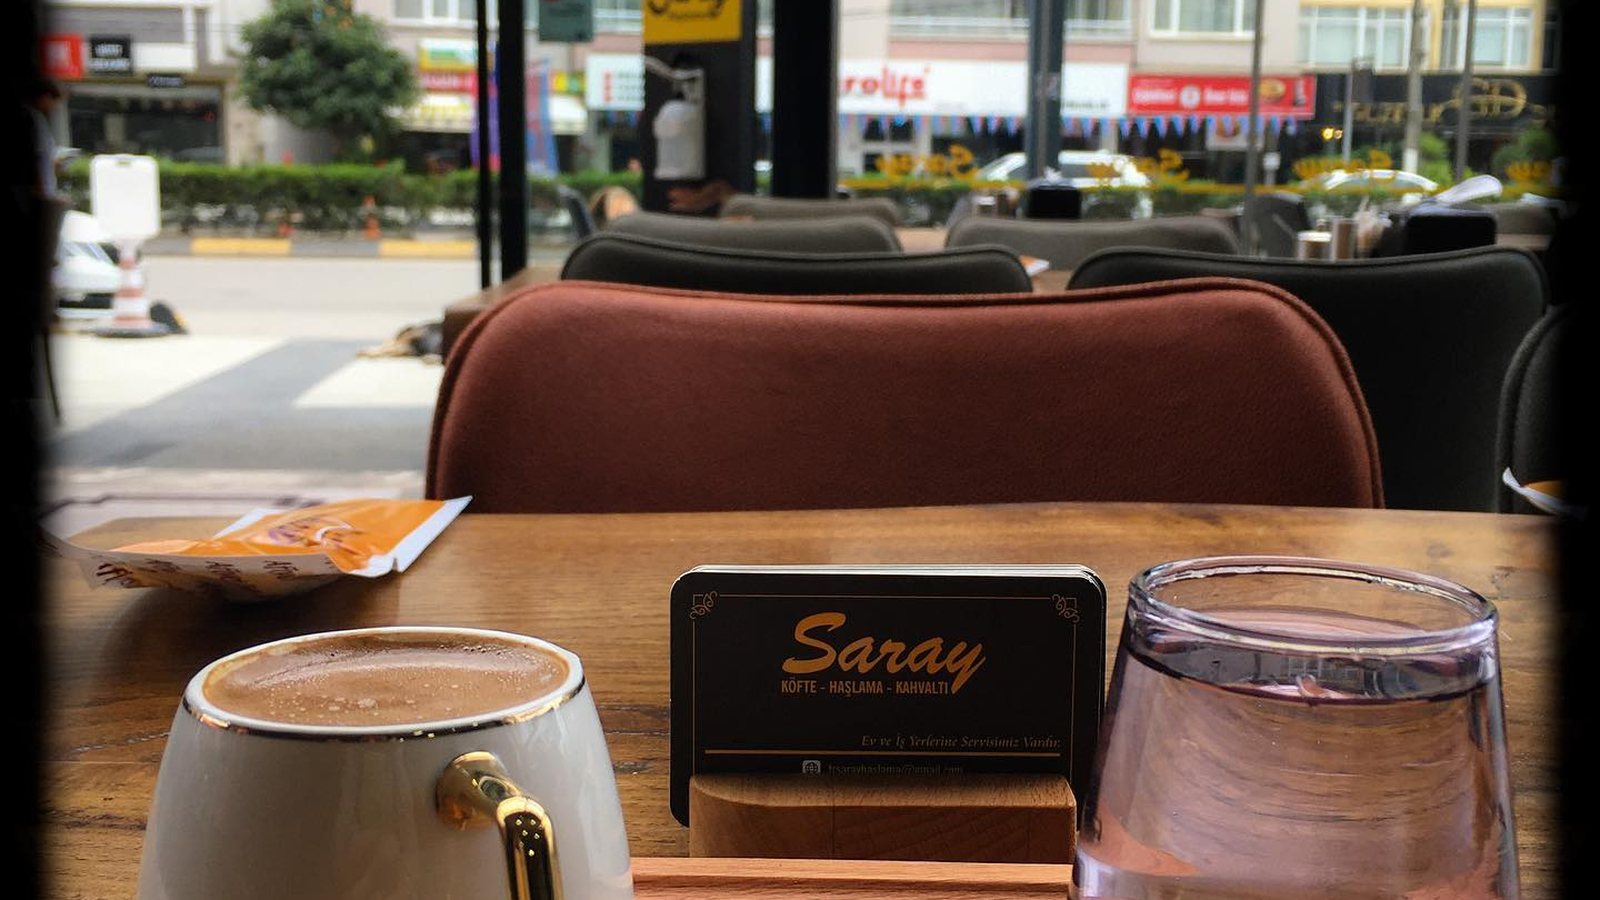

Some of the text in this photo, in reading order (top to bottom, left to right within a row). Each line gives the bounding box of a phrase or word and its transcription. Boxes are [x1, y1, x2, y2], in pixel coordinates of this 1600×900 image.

[782, 612, 986, 694] Saray
[781, 677, 817, 694] KÖFTE
[829, 680, 884, 697] HAŞLAMA
[895, 680, 949, 695] KAHVALTI
[861, 735, 878, 747] Ev
[880, 737, 892, 747] ve
